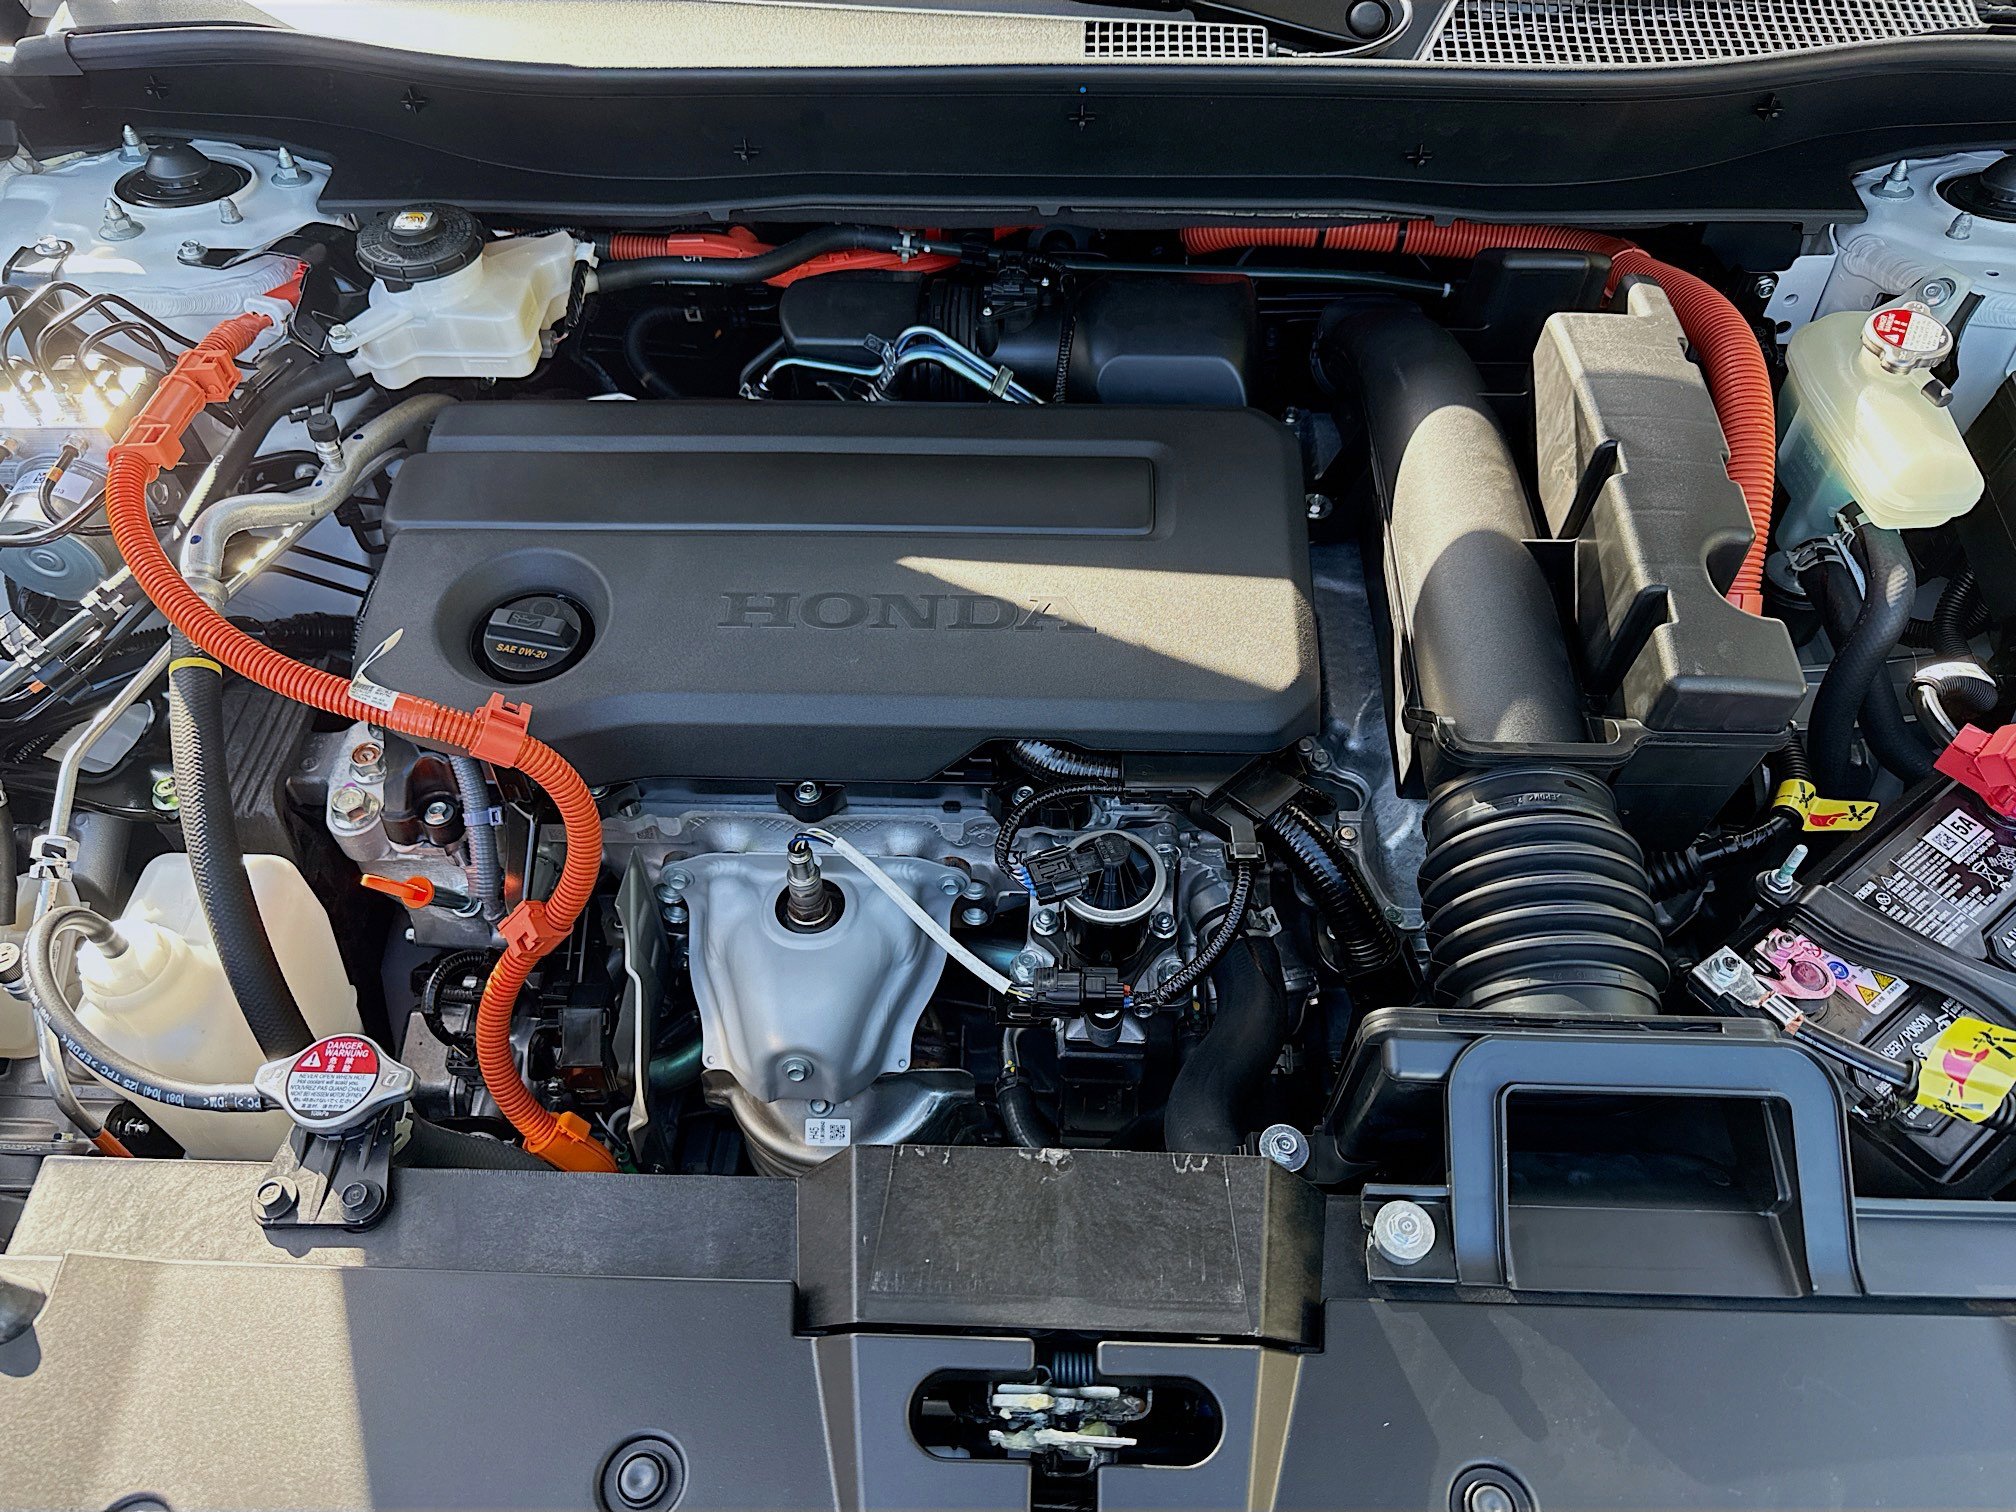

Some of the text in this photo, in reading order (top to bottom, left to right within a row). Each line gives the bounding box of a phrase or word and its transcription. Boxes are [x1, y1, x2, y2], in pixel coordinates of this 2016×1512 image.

[717, 591, 1097, 633] HONDA
[496, 643, 548, 660] SAE 0W-20
[1950, 816, 1978, 835] 5A
[2000, 881, 2012, 892] Pb
[1880, 1013, 1934, 1058] GER/POISON
[60, 1034, 98, 1068] >EPDM<
[324, 1049, 369, 1058] WARNUNG
[326, 1042, 364, 1050] DANGER
[100, 1066, 120, 1082] TPC
